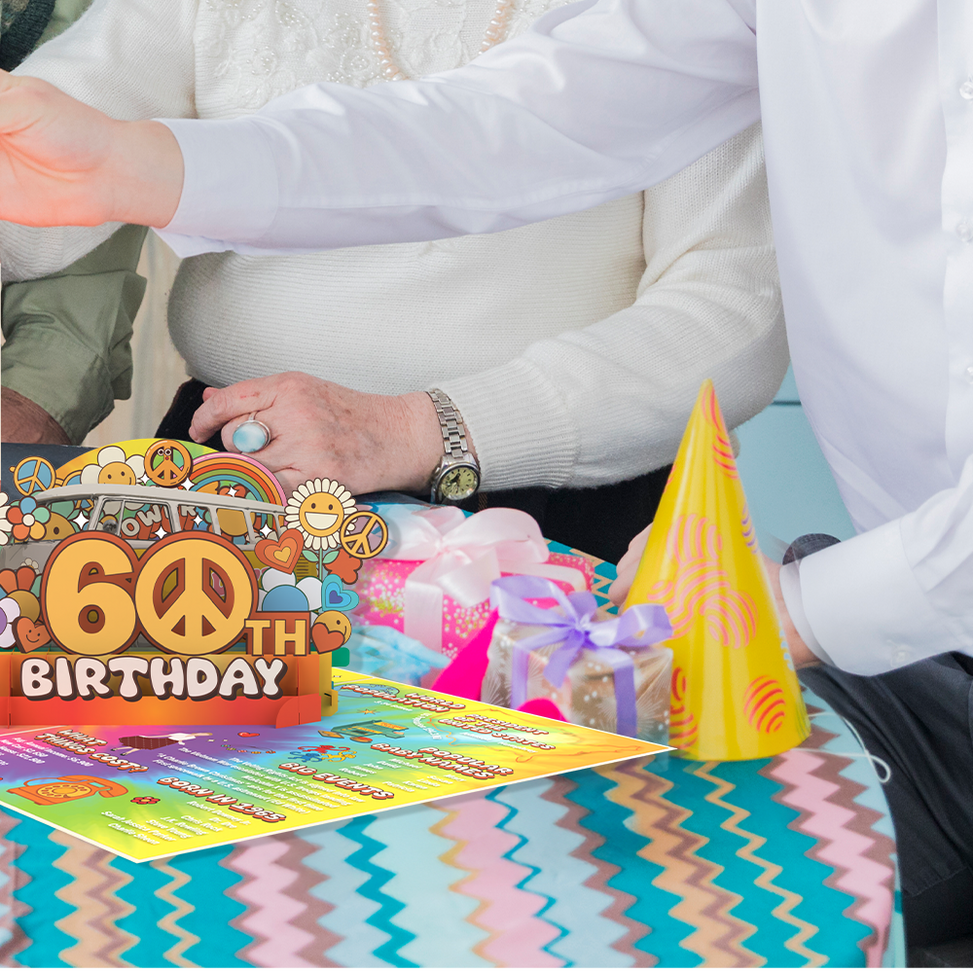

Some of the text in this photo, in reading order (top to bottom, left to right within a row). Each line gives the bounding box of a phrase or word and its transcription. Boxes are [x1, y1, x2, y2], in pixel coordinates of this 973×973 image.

[20, 656, 288, 701] BIRTHDAY
[340, 684, 450, 713] POPULATION
[405, 692, 466, 709] WORLD
[56, 729, 107, 747] WHAT
[438, 718, 493, 734] UNITED
[492, 731, 556, 750] STATES
[465, 714, 549, 735] PRESIDENT
[475, 721, 508, 732] THE
[34, 732, 96, 755] THINGS
[370, 743, 495, 780] BABY NAMES
[418, 747, 514, 776] POPULAR
[278, 762, 394, 800] BIG EVENTS
[157, 777, 286, 823] BORN IN 1965
